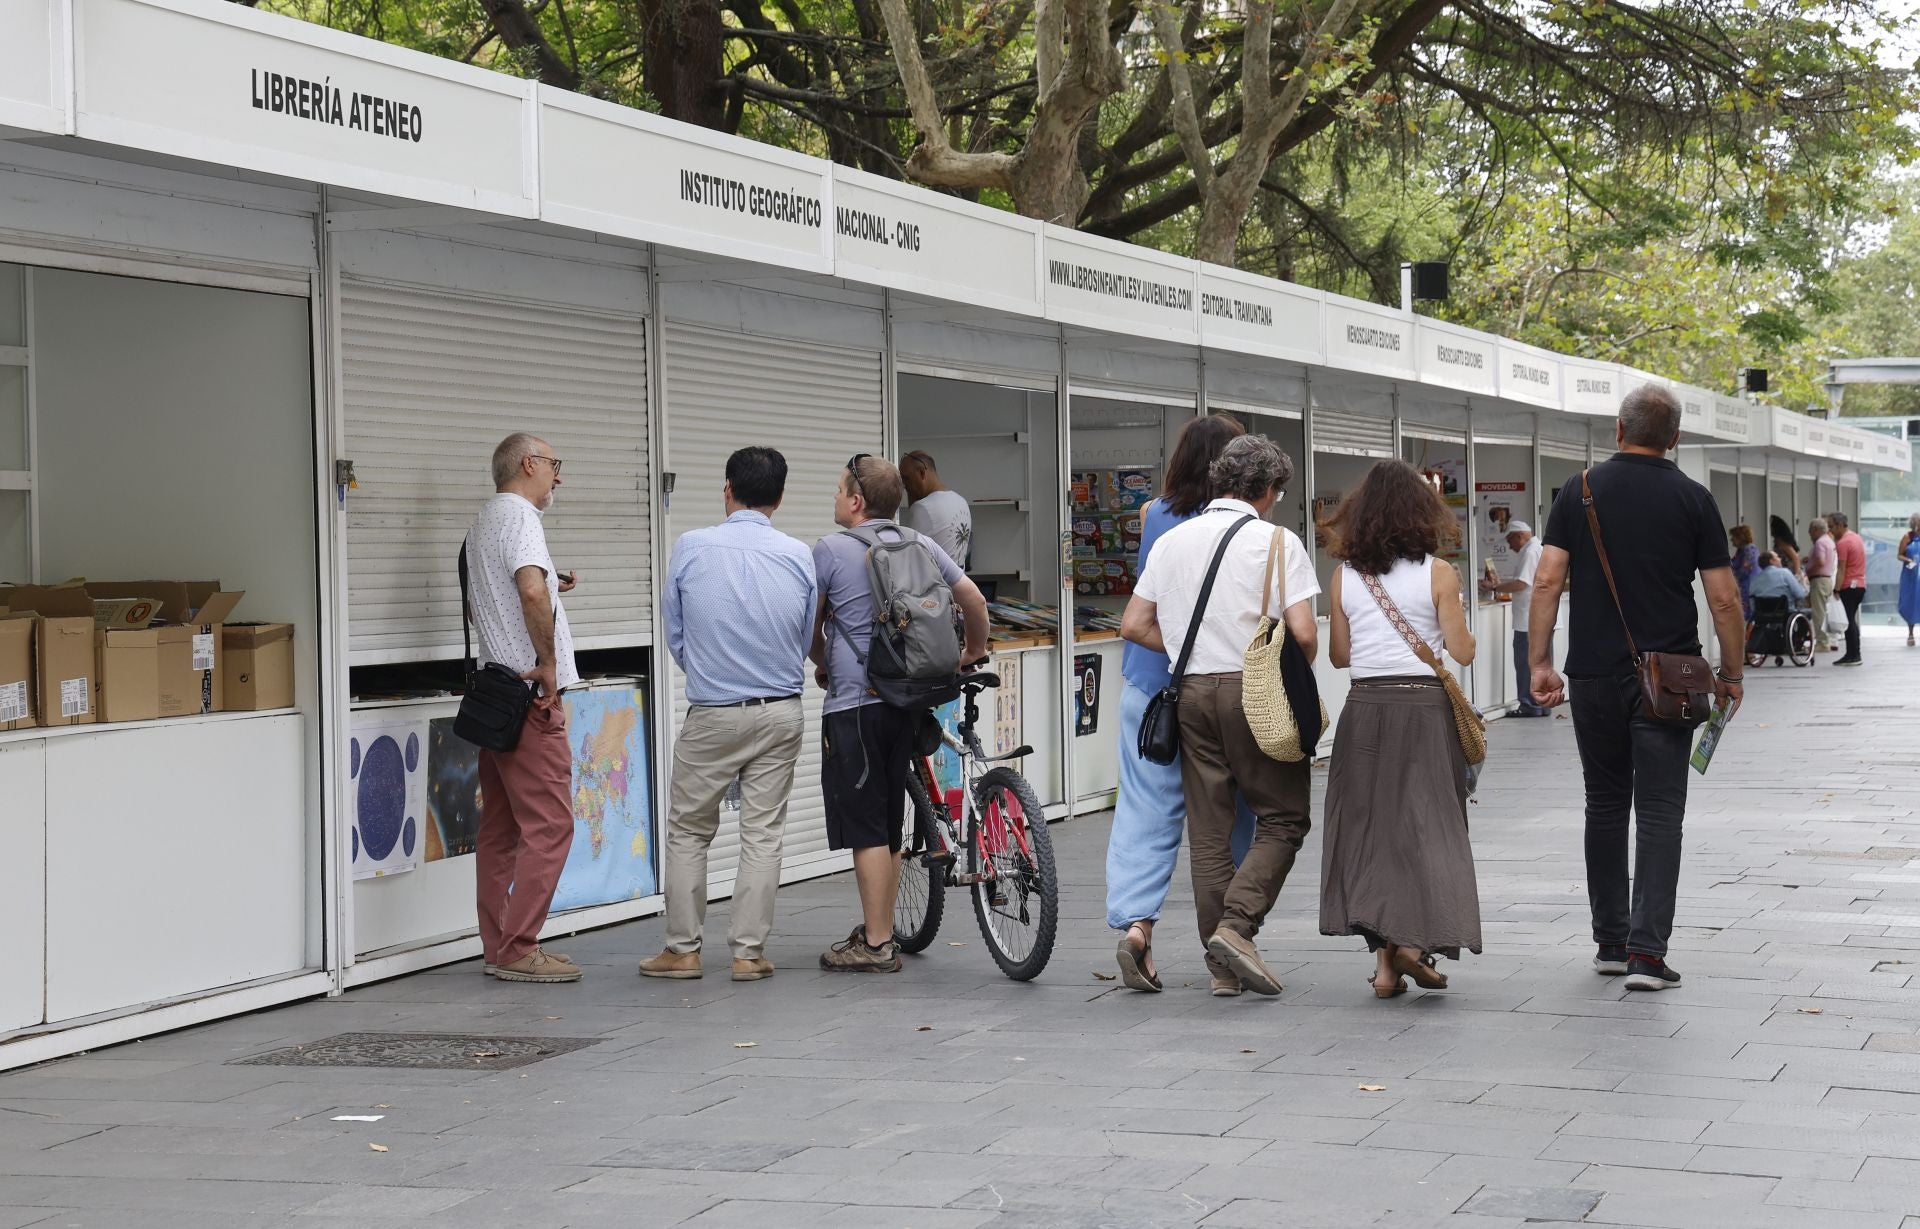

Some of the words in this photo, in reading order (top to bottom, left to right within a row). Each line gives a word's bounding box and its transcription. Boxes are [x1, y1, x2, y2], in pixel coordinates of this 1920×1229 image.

[251, 68, 344, 126] LIBRERÍA
[348, 92, 423, 143] ATENEO
[680, 169, 746, 213] INSTITUTO
[749, 185, 822, 228] GEOGRÁFICO
[836, 206, 889, 245] NACIONAL
[897, 220, 921, 252] CNIG
[1049, 259, 1193, 311] WWW.LIBROSINFANTILESYJUVENILES.COM
[1202, 293, 1233, 319] EDITORIAL
[1234, 300, 1273, 326] TRAMUNTANA
[1346, 324, 1378, 348] MENOSCUARTO
[1379, 332, 1400, 351] EDICIONES
